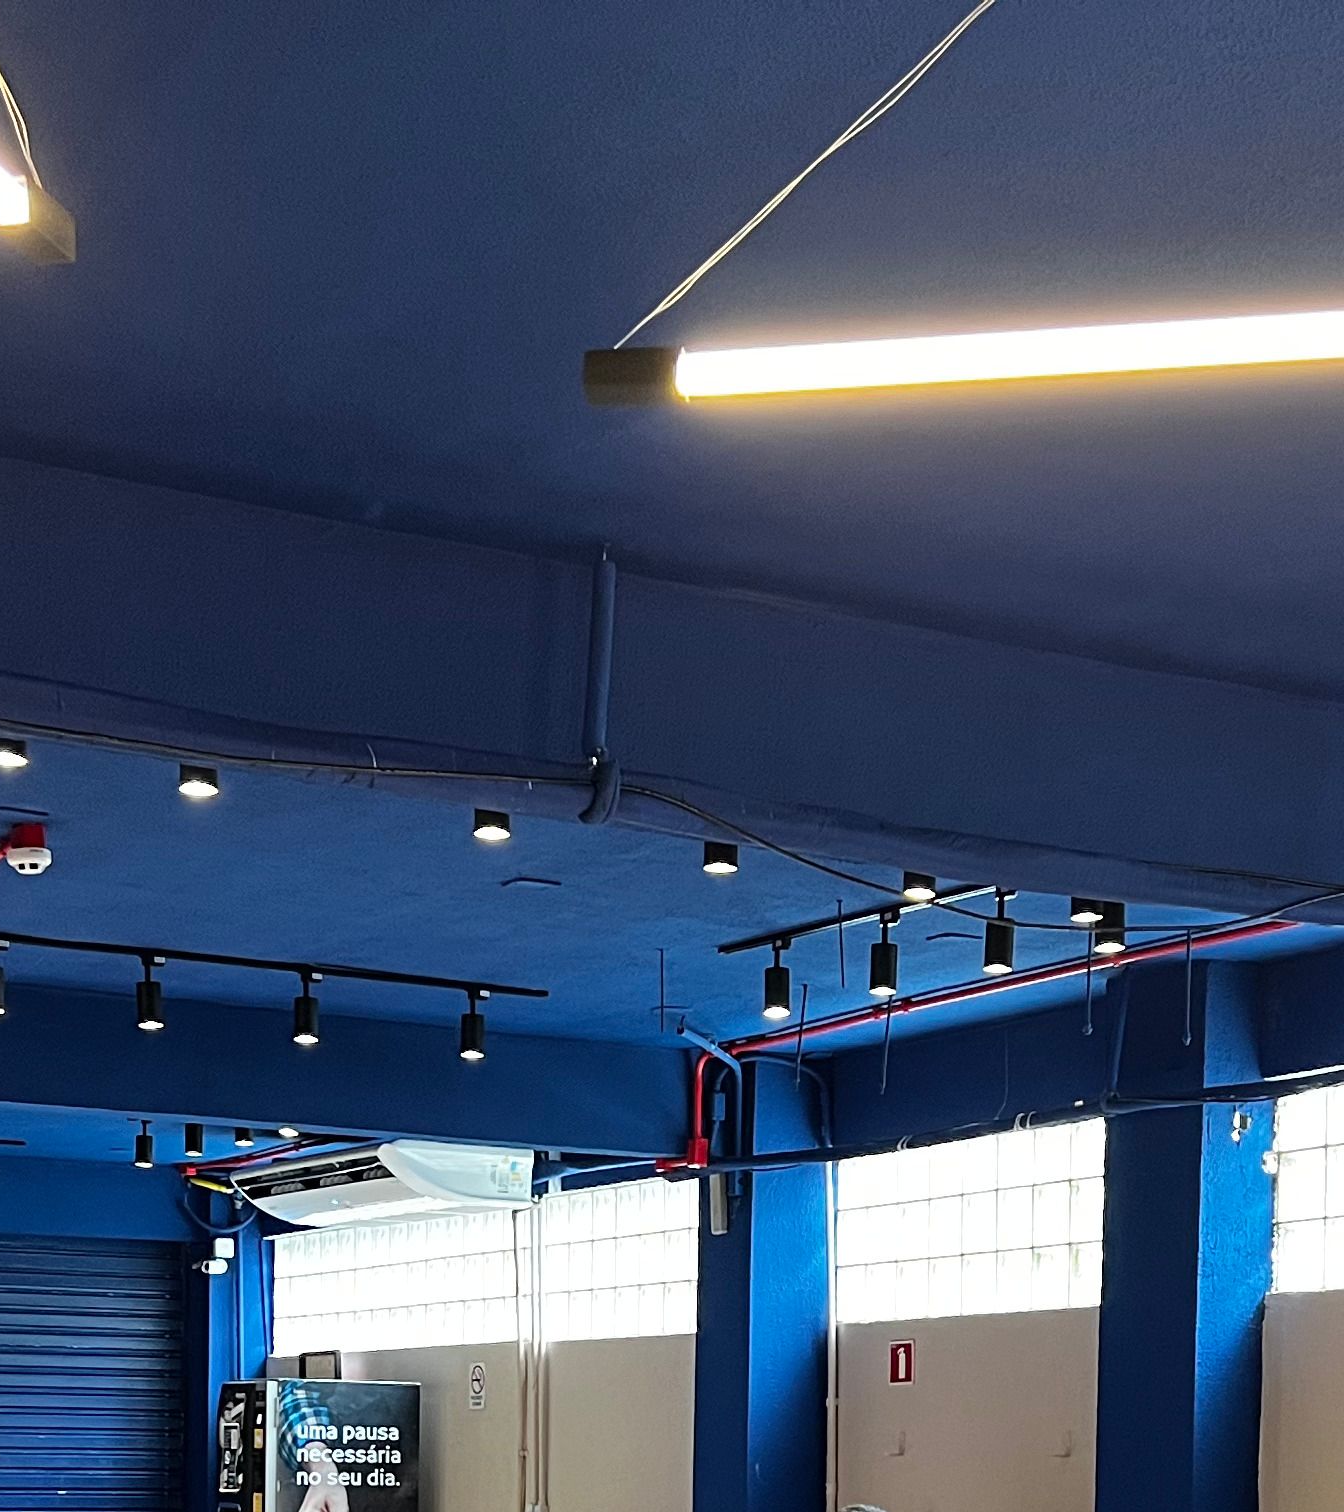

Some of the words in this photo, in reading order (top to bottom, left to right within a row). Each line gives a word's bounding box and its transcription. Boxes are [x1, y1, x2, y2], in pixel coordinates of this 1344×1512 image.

[296, 1424, 338, 1440] uma
[342, 1425, 400, 1445] pausa
[296, 1444, 402, 1464] necessária
[296, 1471, 322, 1486] no
[327, 1472, 362, 1487] seu
[366, 1468, 401, 1487] dia.
